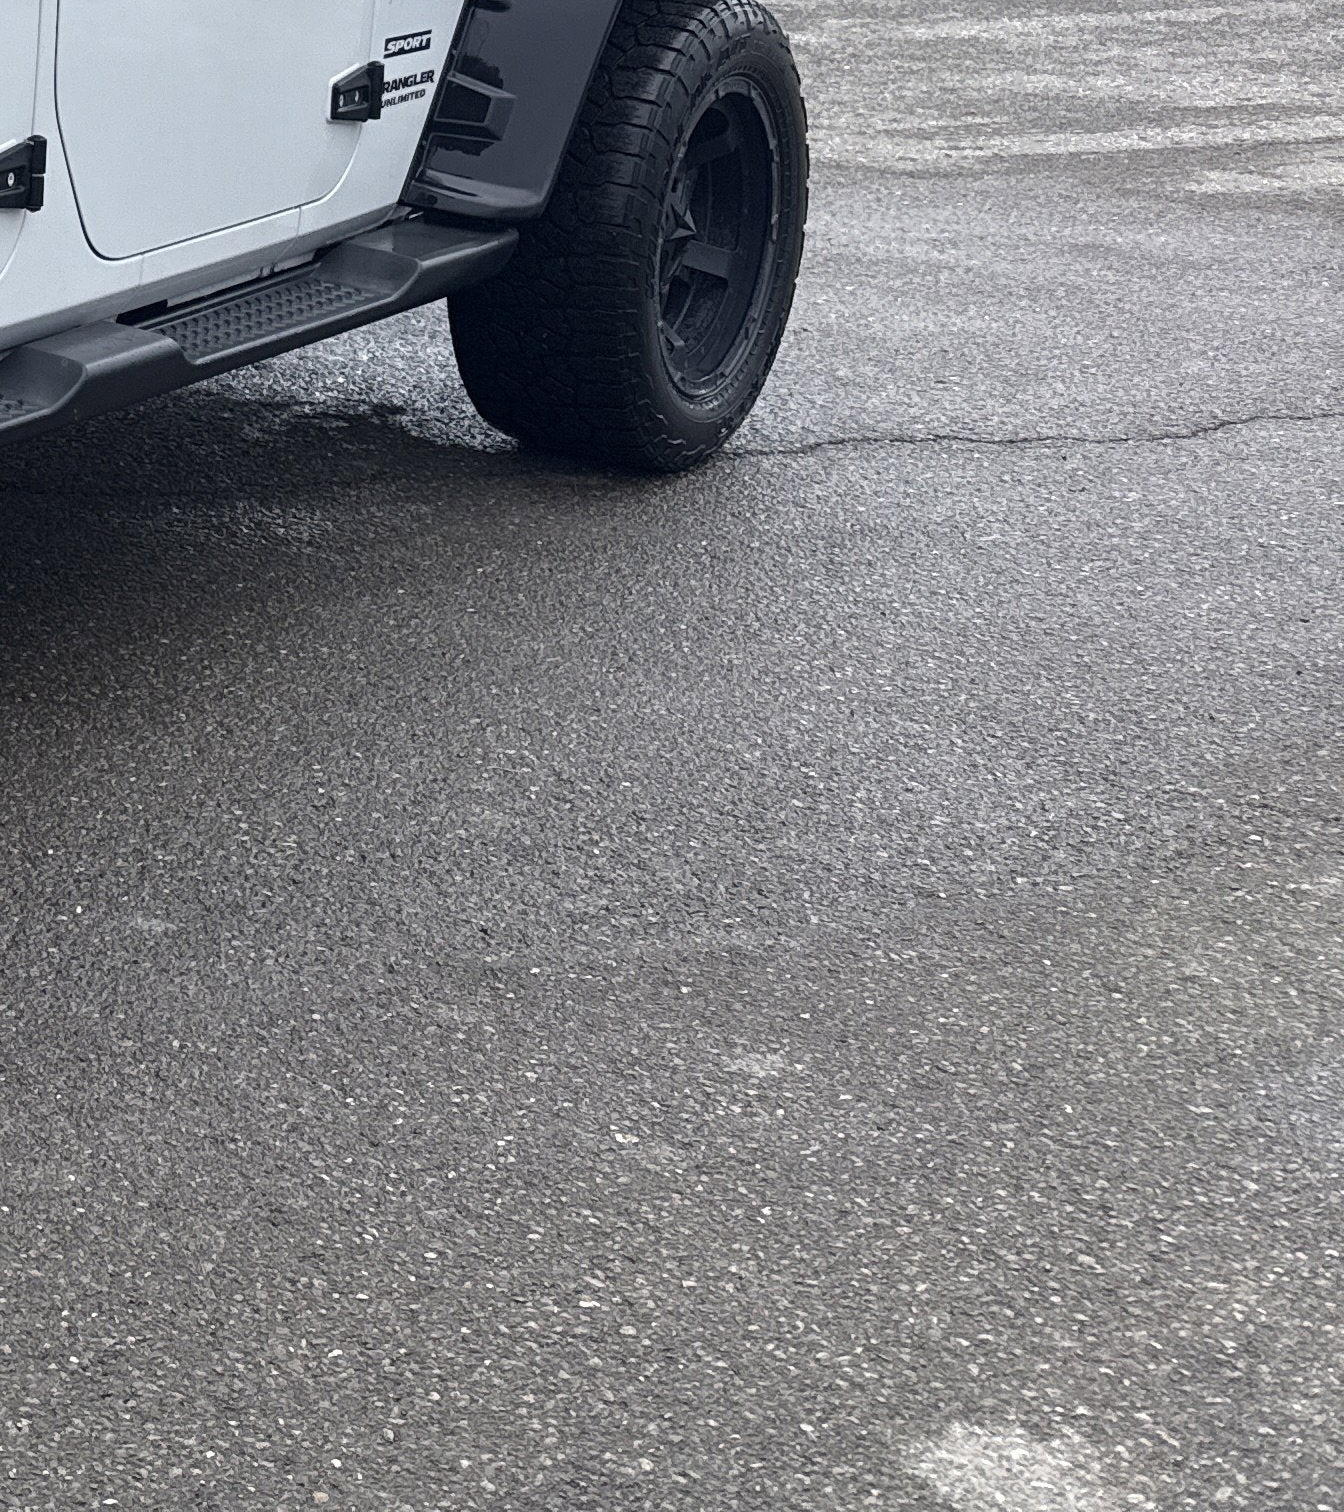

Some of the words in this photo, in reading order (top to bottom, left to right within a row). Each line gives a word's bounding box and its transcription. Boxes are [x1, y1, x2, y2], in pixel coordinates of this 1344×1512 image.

[384, 33, 431, 55] SPORT
[382, 70, 434, 95] RANGLER
[380, 88, 425, 109] UNLIMITED
